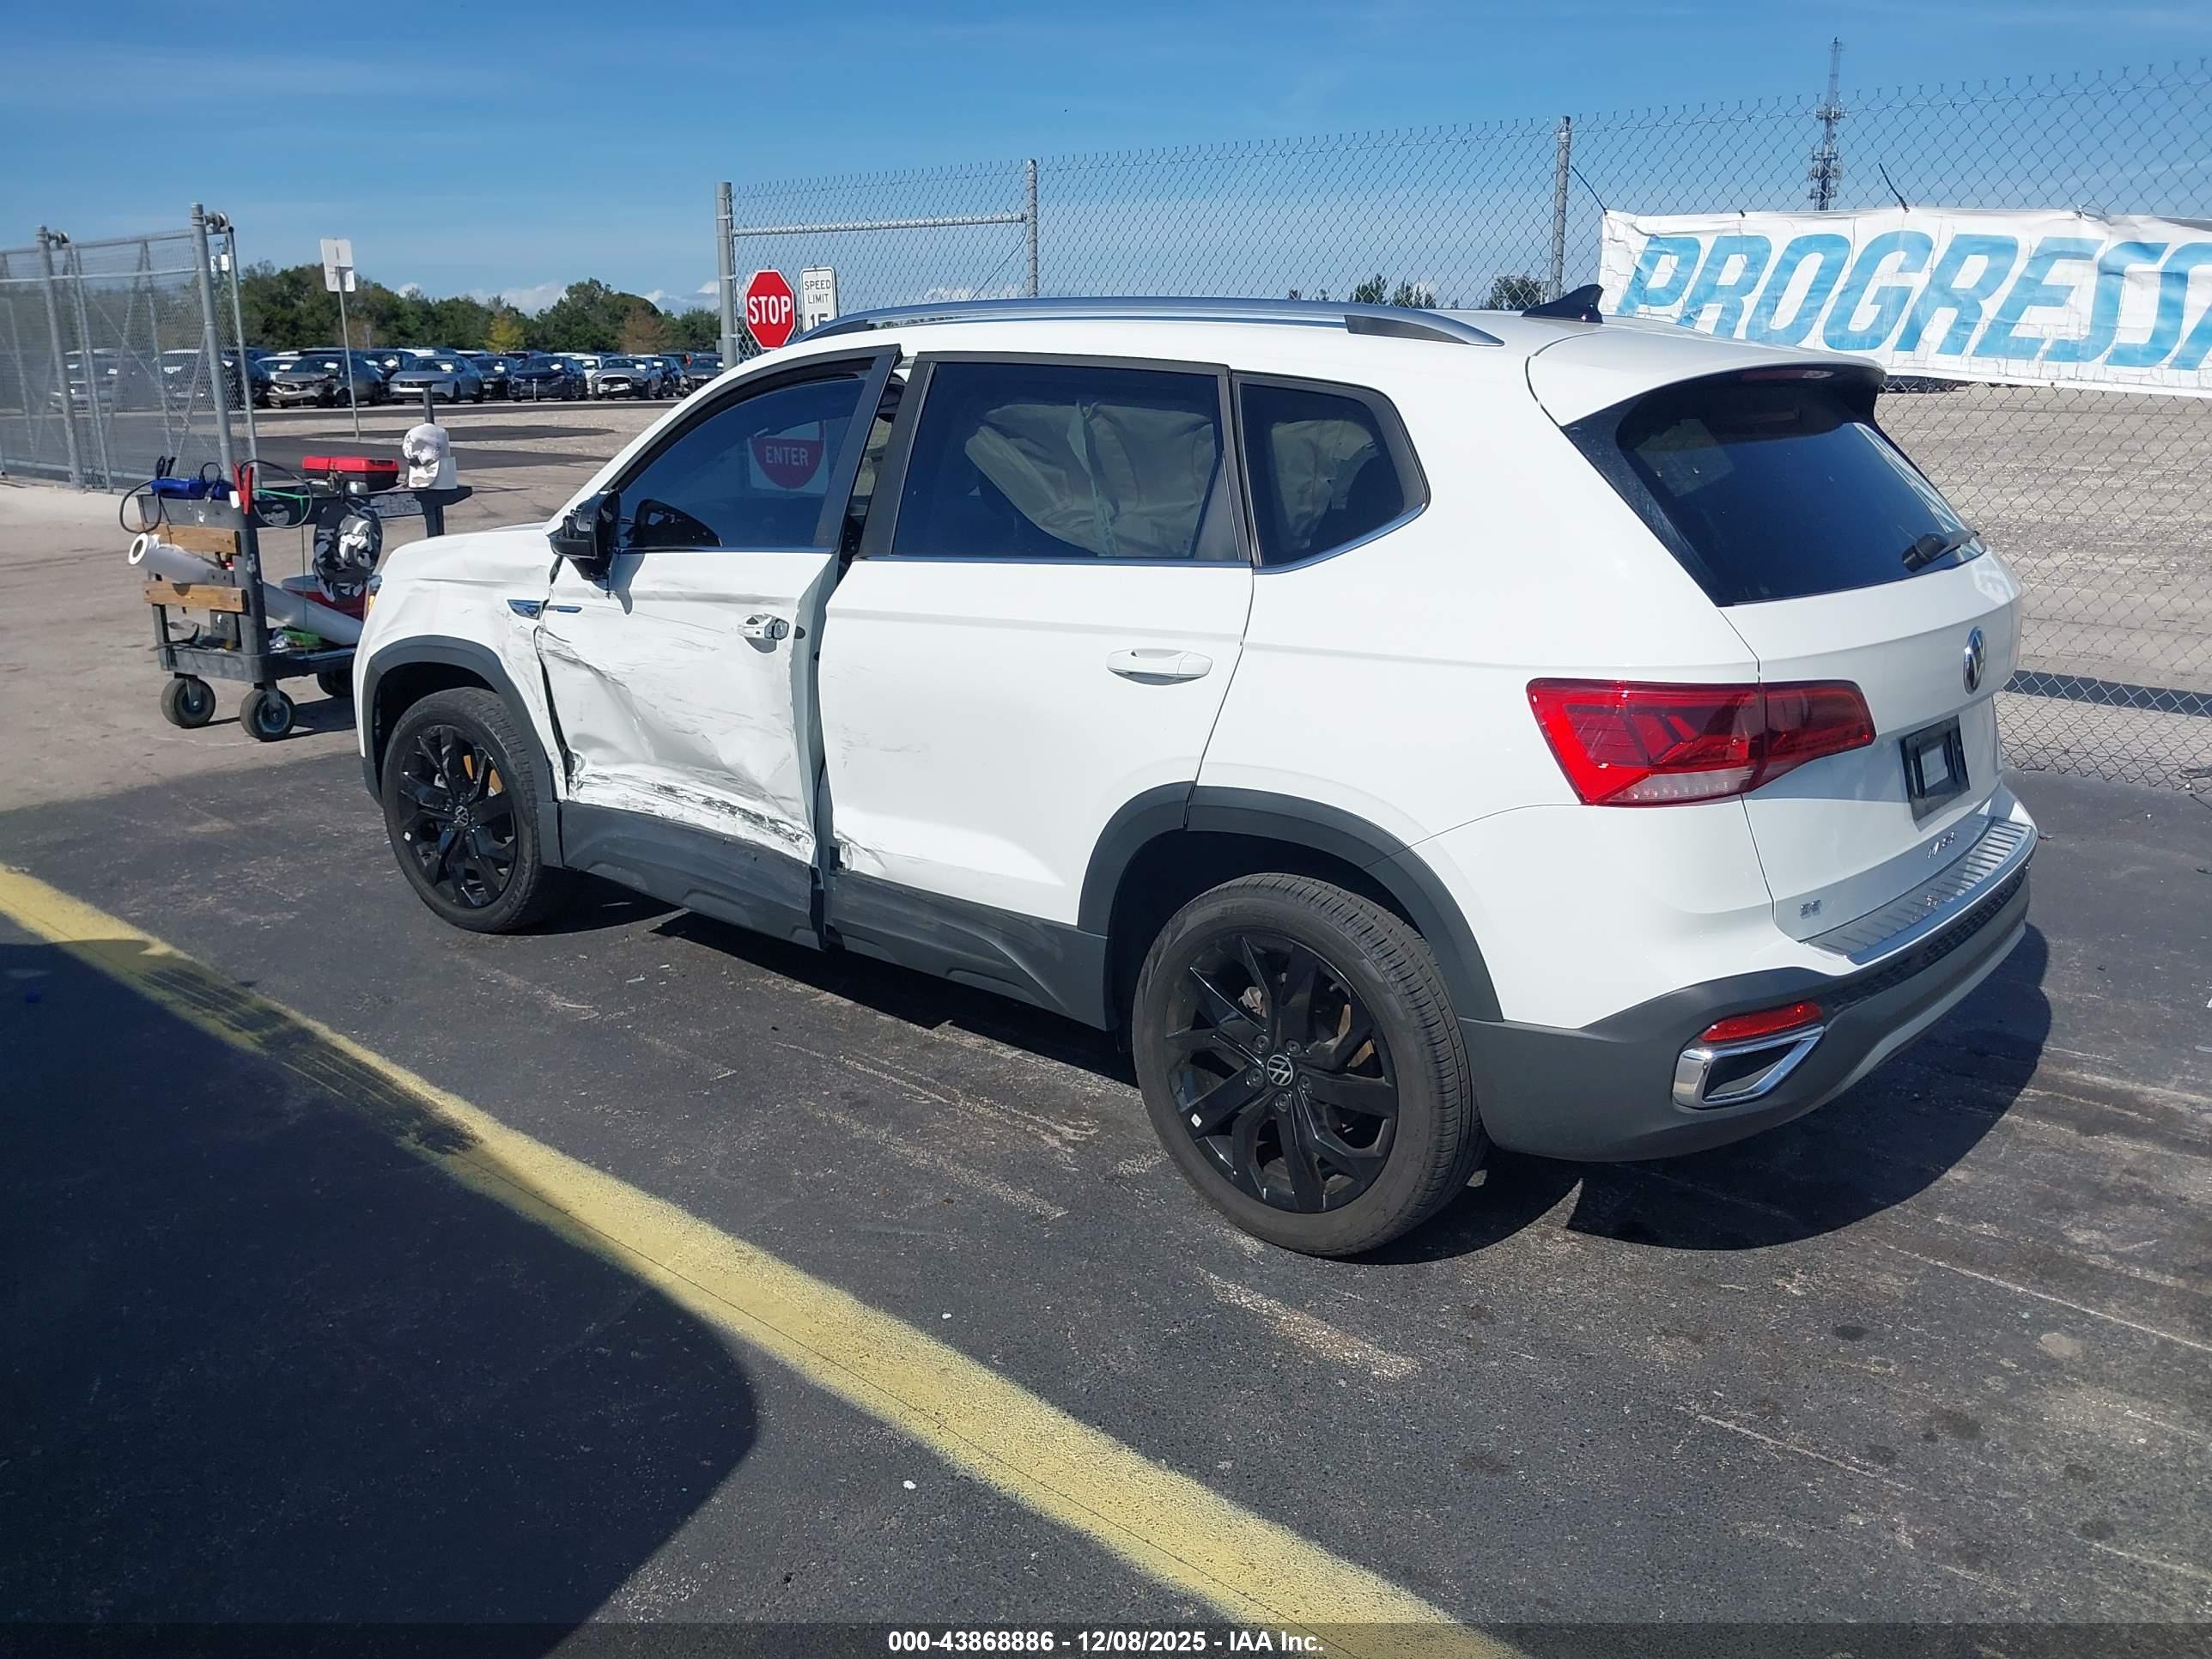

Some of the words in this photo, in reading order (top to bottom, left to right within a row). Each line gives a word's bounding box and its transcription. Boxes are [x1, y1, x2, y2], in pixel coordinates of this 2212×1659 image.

[804, 279, 831, 290] SPEED
[807, 293, 830, 304] LIMIT
[1615, 231, 2212, 371] PROGRESS
[748, 295, 792, 325] STOP
[765, 446, 809, 466] ENTER
